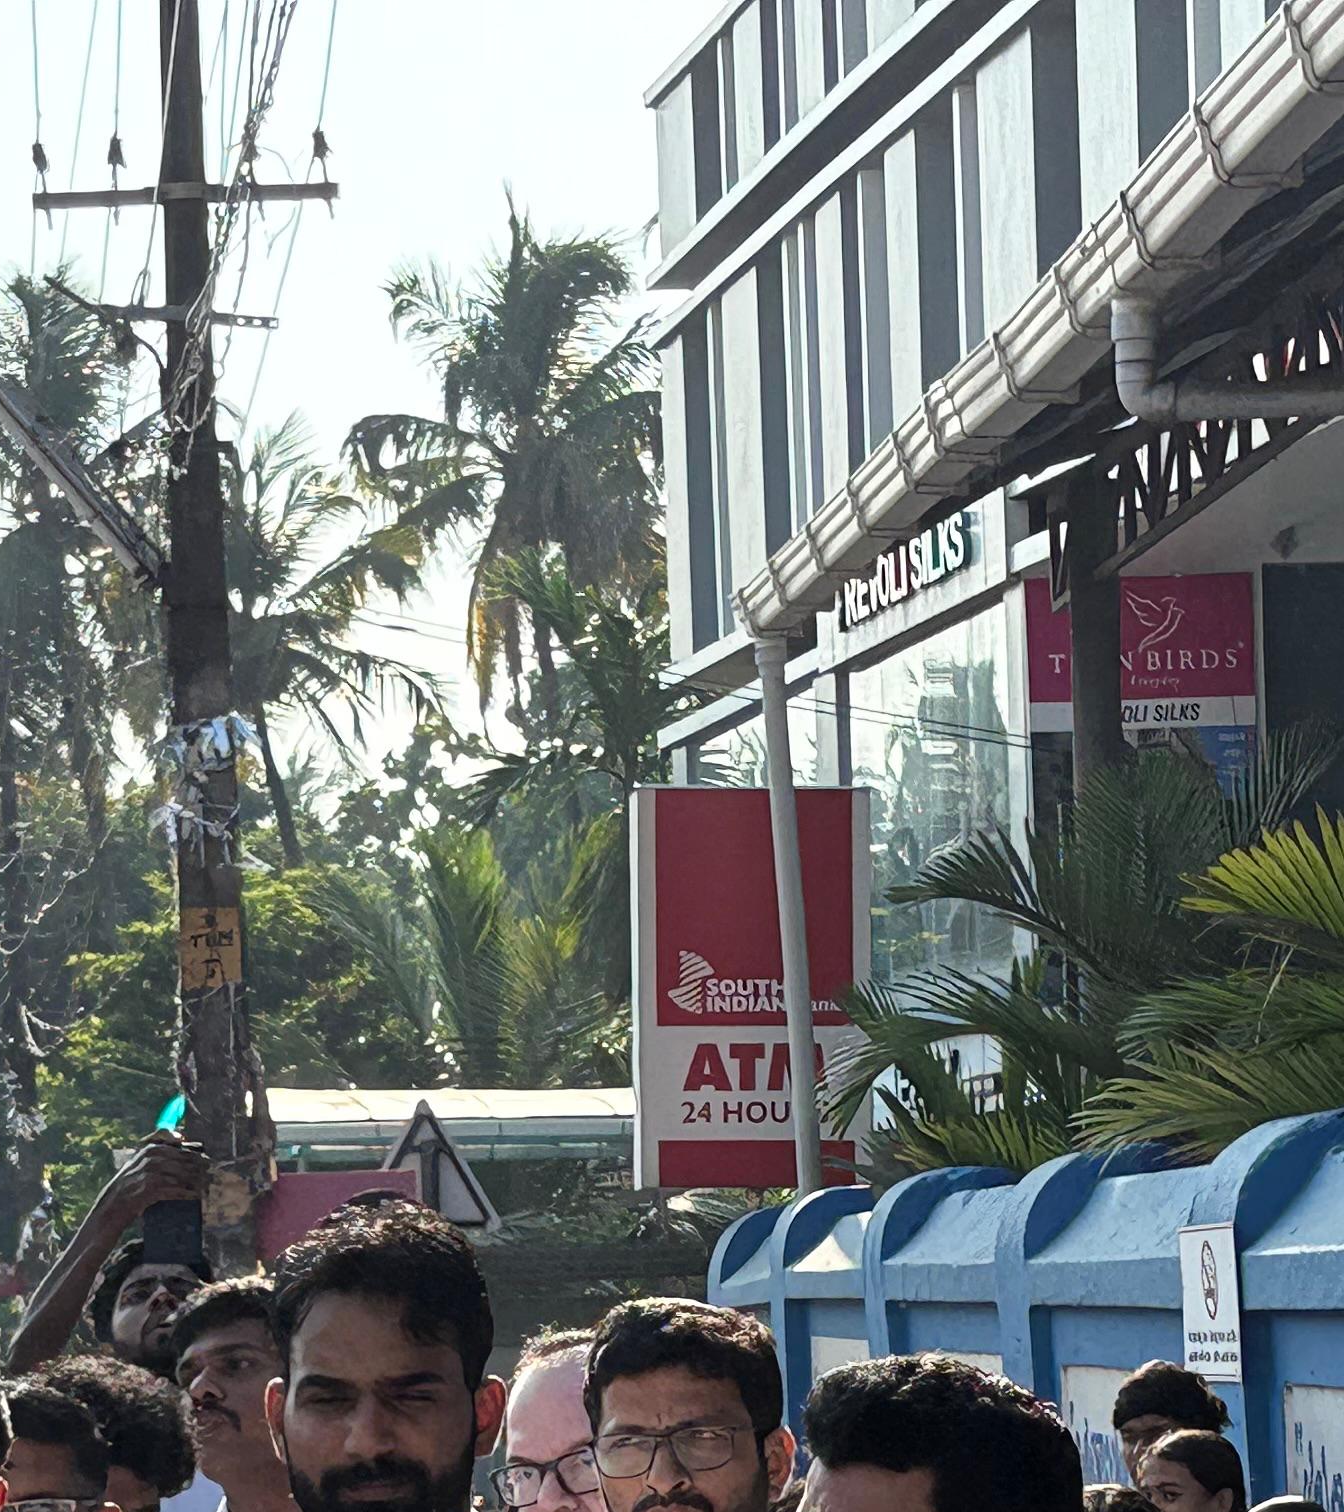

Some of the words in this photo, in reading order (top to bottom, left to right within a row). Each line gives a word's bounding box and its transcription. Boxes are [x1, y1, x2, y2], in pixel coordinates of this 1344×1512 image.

[909, 511, 964, 590] SILKS
[1049, 650, 1134, 674] TN
[1147, 649, 1237, 671] BIRDS
[1153, 702, 1200, 722] SILKS
[705, 978, 785, 996] SOUTH
[706, 996, 787, 1013] INDIAN
[810, 999, 842, 1012] ank
[681, 1101, 712, 1124] 24
[723, 1101, 790, 1124] HOU
